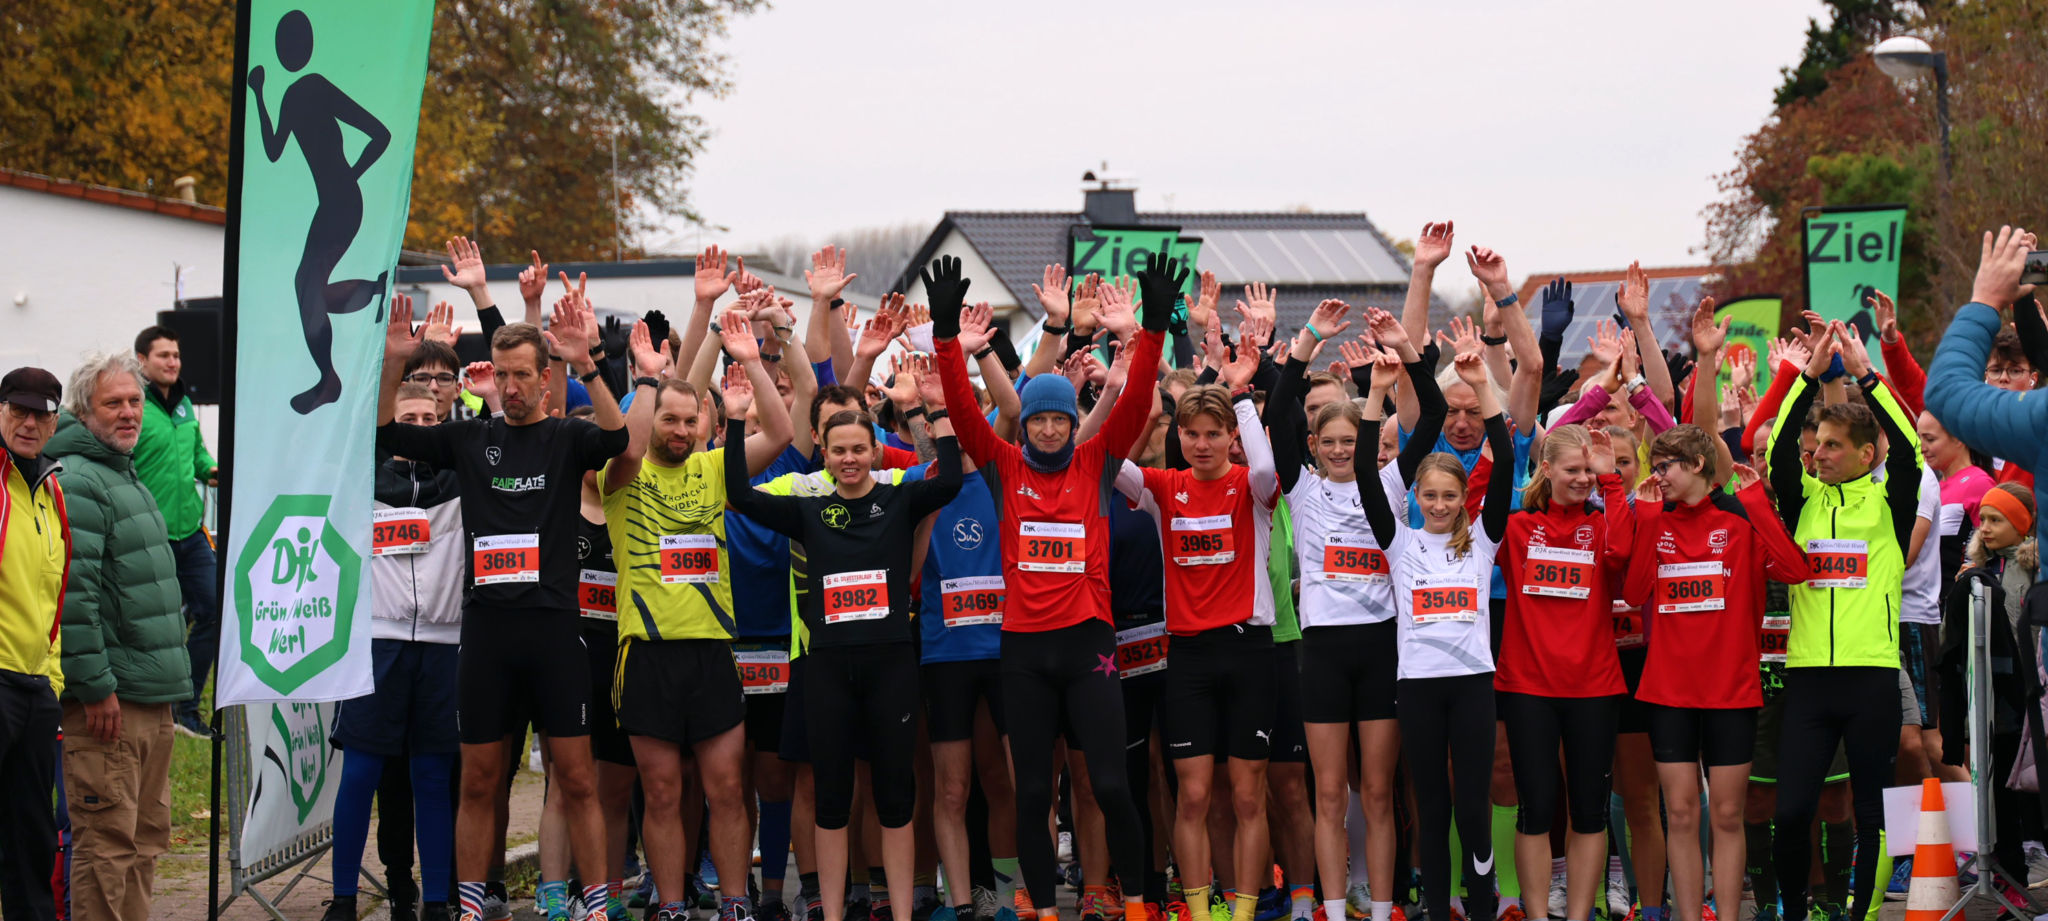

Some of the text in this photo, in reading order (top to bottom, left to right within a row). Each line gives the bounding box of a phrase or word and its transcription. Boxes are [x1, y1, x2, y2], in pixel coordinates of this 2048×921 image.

[1809, 221, 1898, 263] Ziel
[1716, 322, 1770, 336] ende-
[492, 474, 545, 489] FAIRFLATS
[374, 524, 420, 543] 3746
[956, 523, 981, 542] SuS
[1028, 540, 1073, 558] 3701
[1180, 534, 1223, 552] 3965
[483, 551, 526, 571] 3681
[671, 552, 712, 570] 3696
[1334, 550, 1381, 571] 3545
[1813, 556, 1858, 574] 3449
[841, 574, 872, 582] SILVESTERLAUF
[1534, 564, 1581, 585] 3615
[832, 588, 878, 609] 3982
[1668, 579, 1713, 599] 3608
[952, 593, 998, 613] 3469
[1421, 590, 1469, 609] 3546
[1612, 616, 1632, 634] 74
[268, 625, 305, 654] Werl
[1121, 639, 1164, 665] 3521
